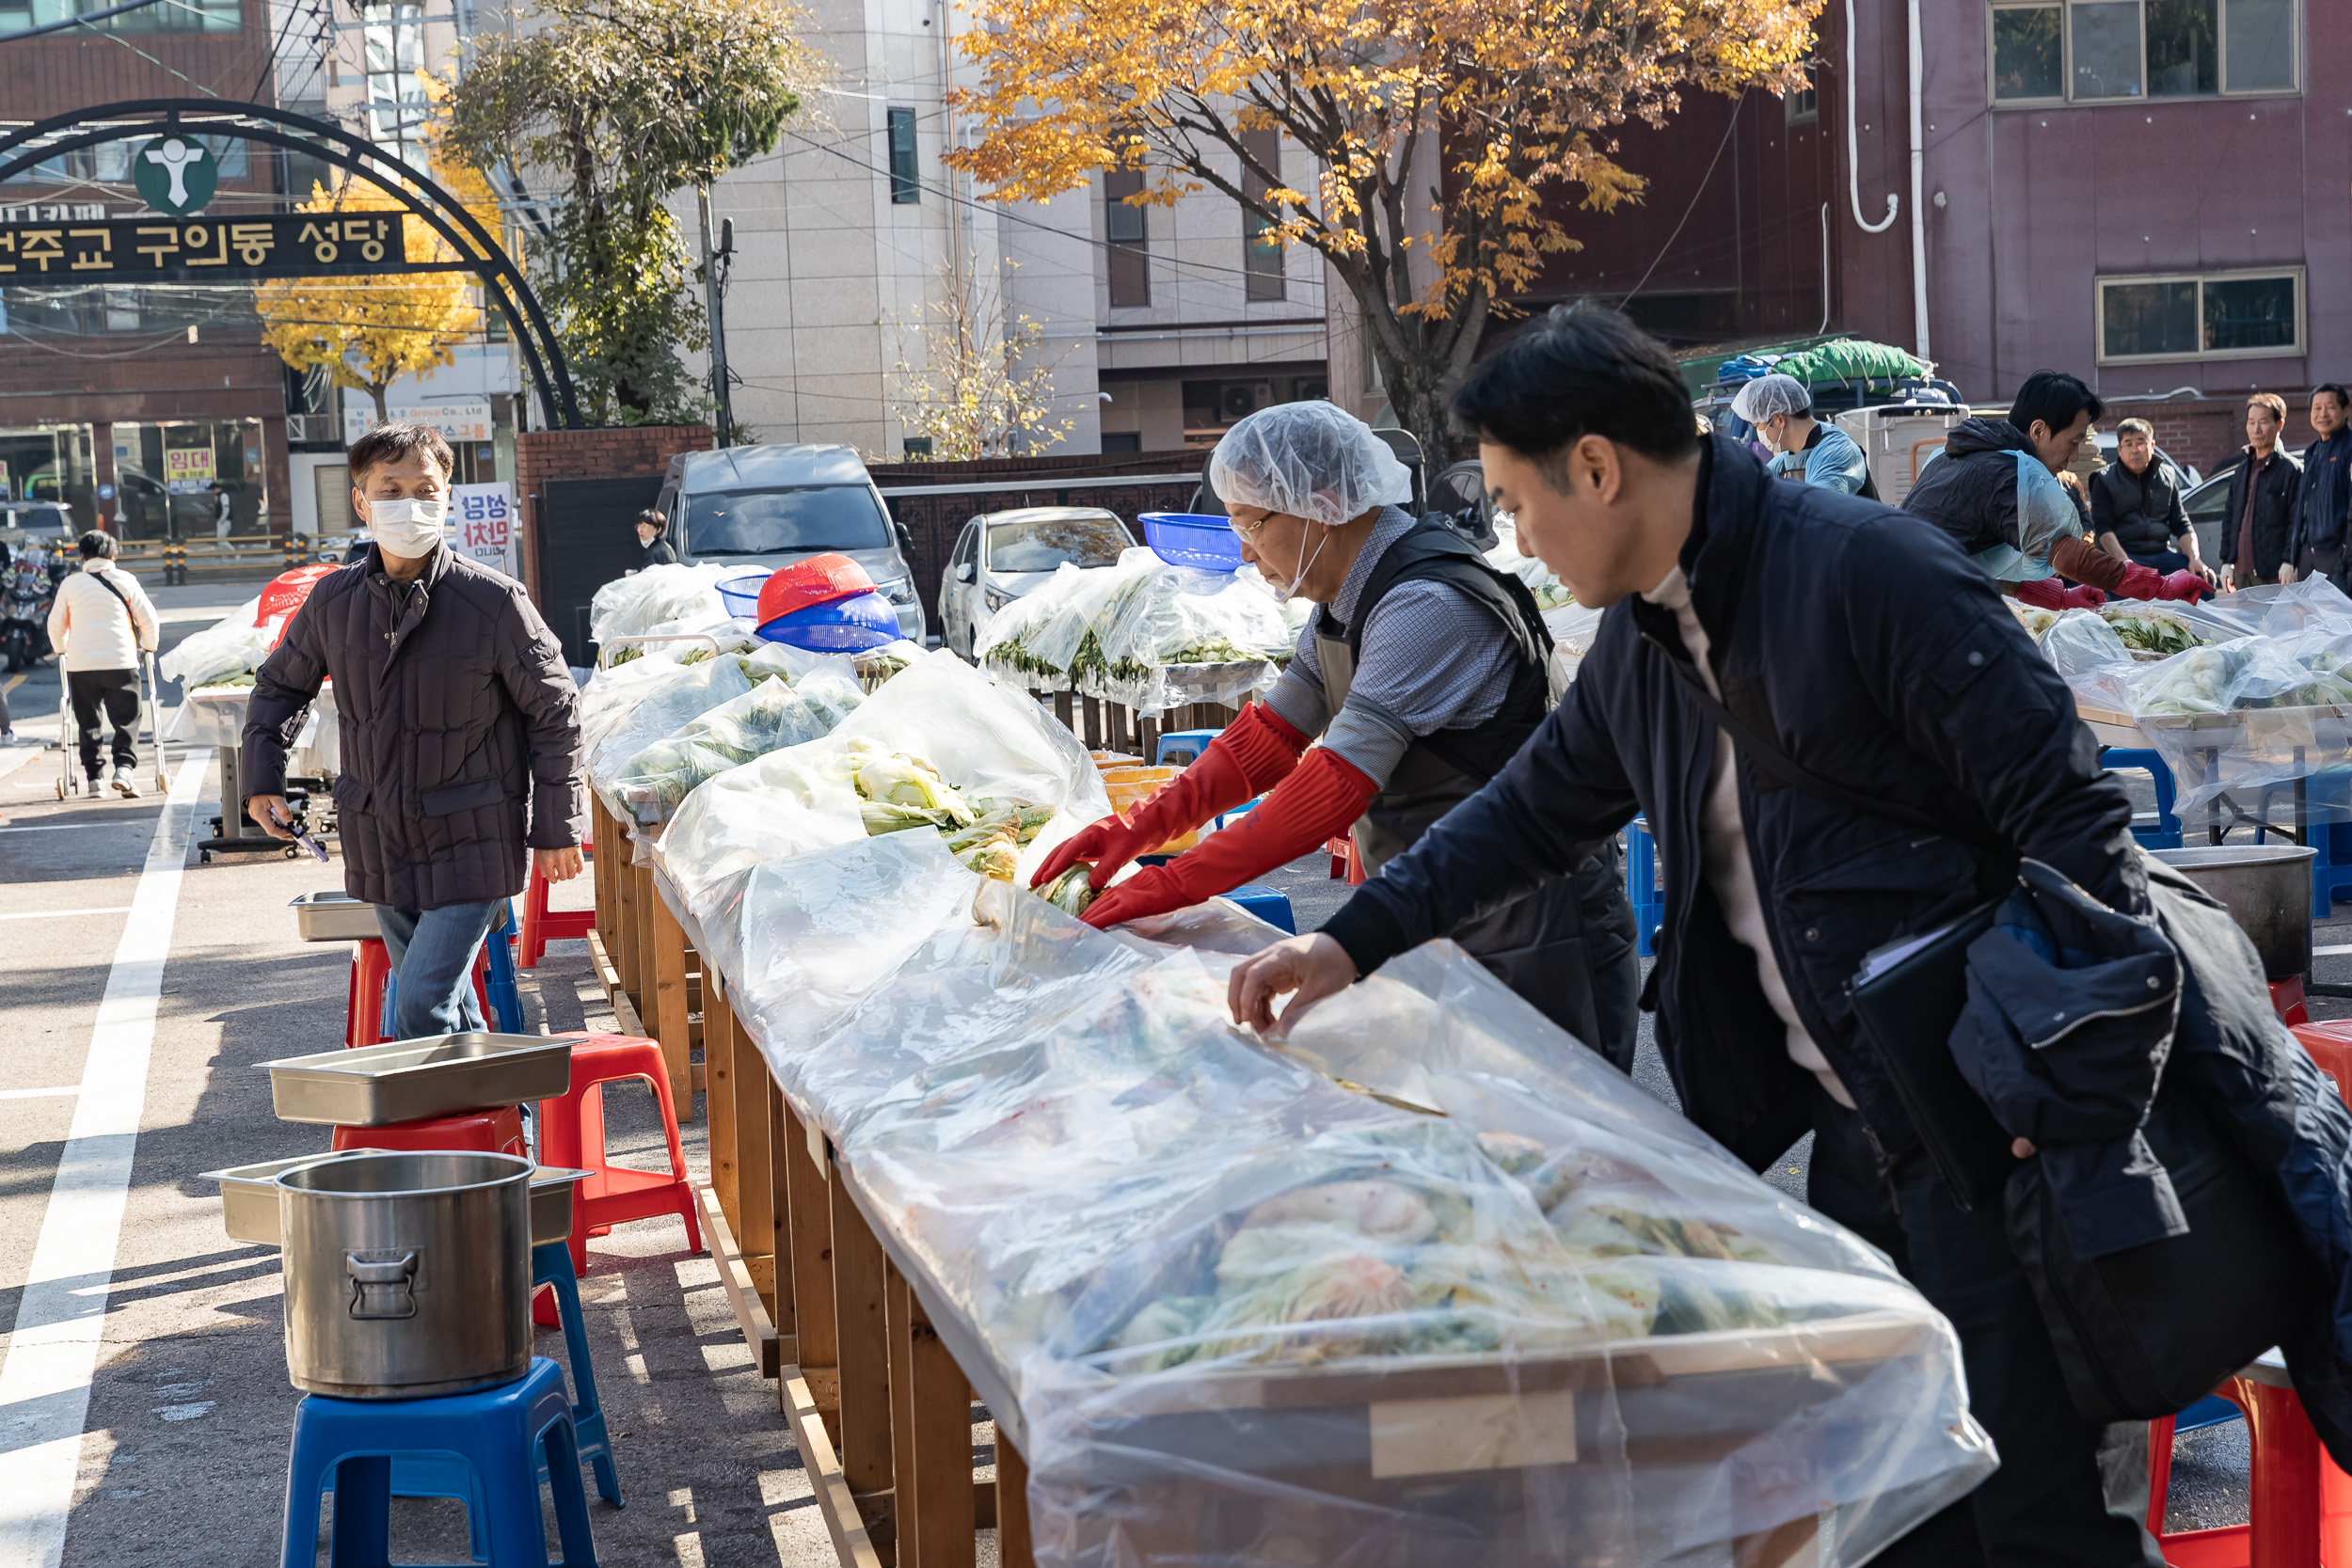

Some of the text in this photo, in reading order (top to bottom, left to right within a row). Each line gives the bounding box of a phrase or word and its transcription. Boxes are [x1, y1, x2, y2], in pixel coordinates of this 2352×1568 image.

[0, 203, 105, 222] 디카페
[136, 223, 276, 268] 구의동
[297, 219, 389, 263] 성당
[170, 451, 209, 469] 임대
